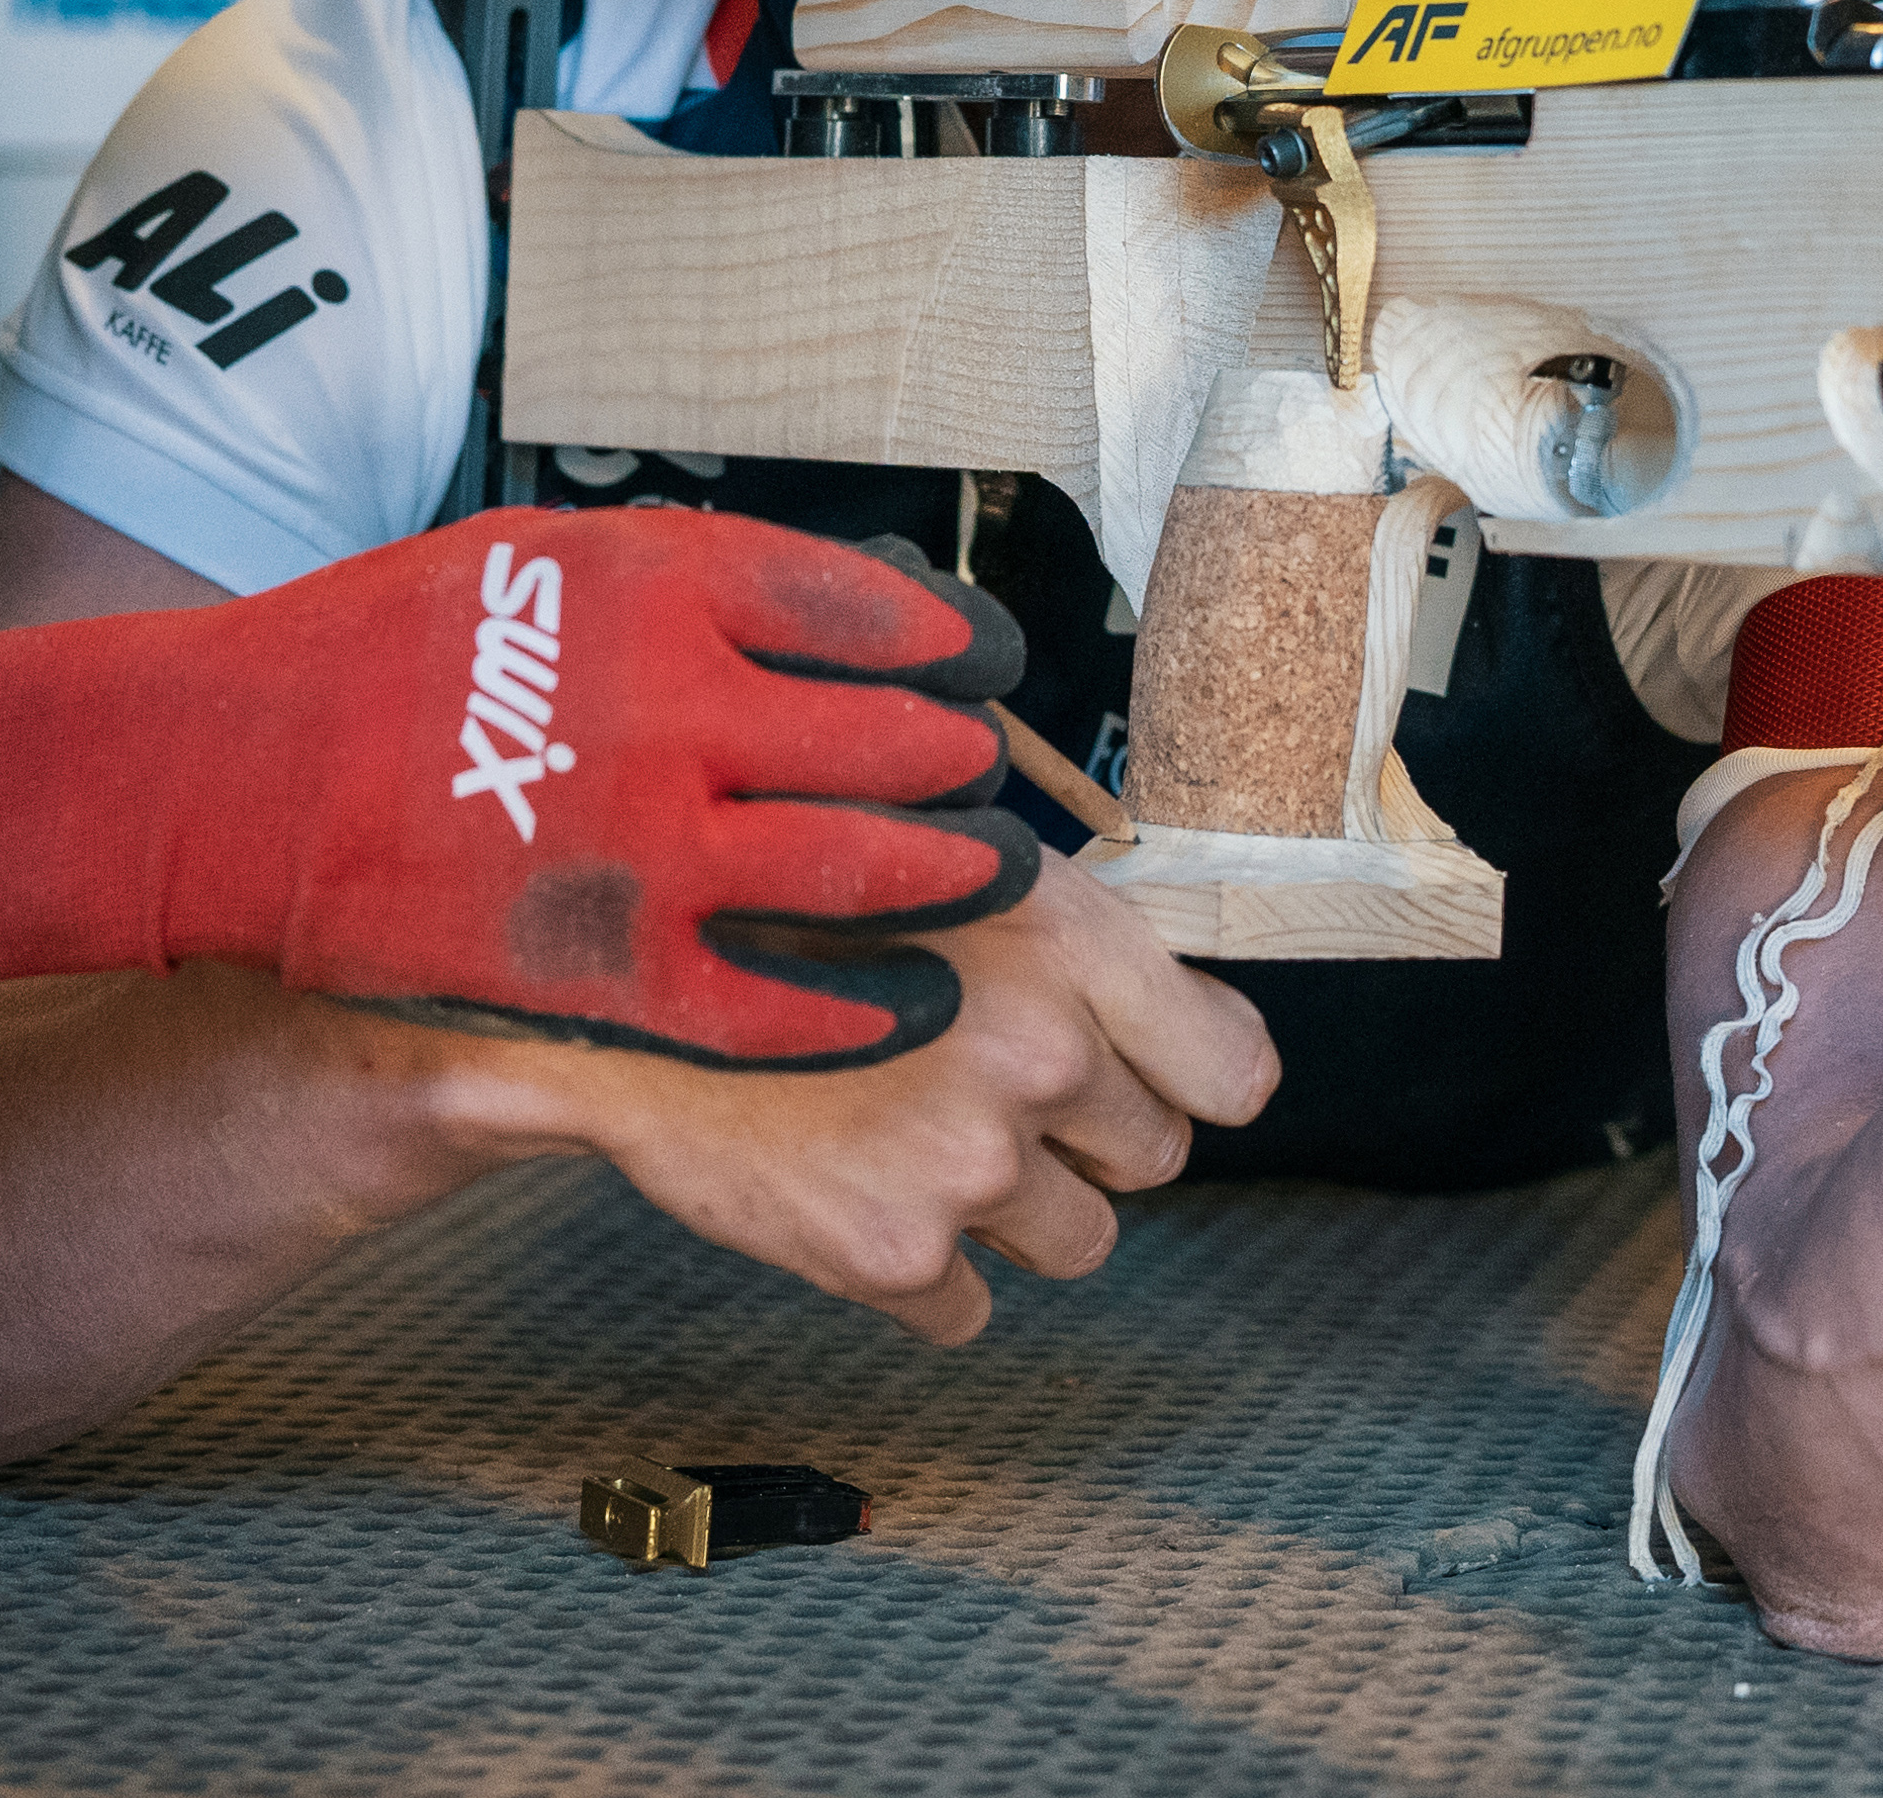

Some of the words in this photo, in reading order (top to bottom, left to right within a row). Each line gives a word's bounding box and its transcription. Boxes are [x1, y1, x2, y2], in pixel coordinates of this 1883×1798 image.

[1347, 2, 1469, 64] AF
[1476, 22, 1664, 68] afgruppen.no
[103, 308, 173, 367] KAFFE
